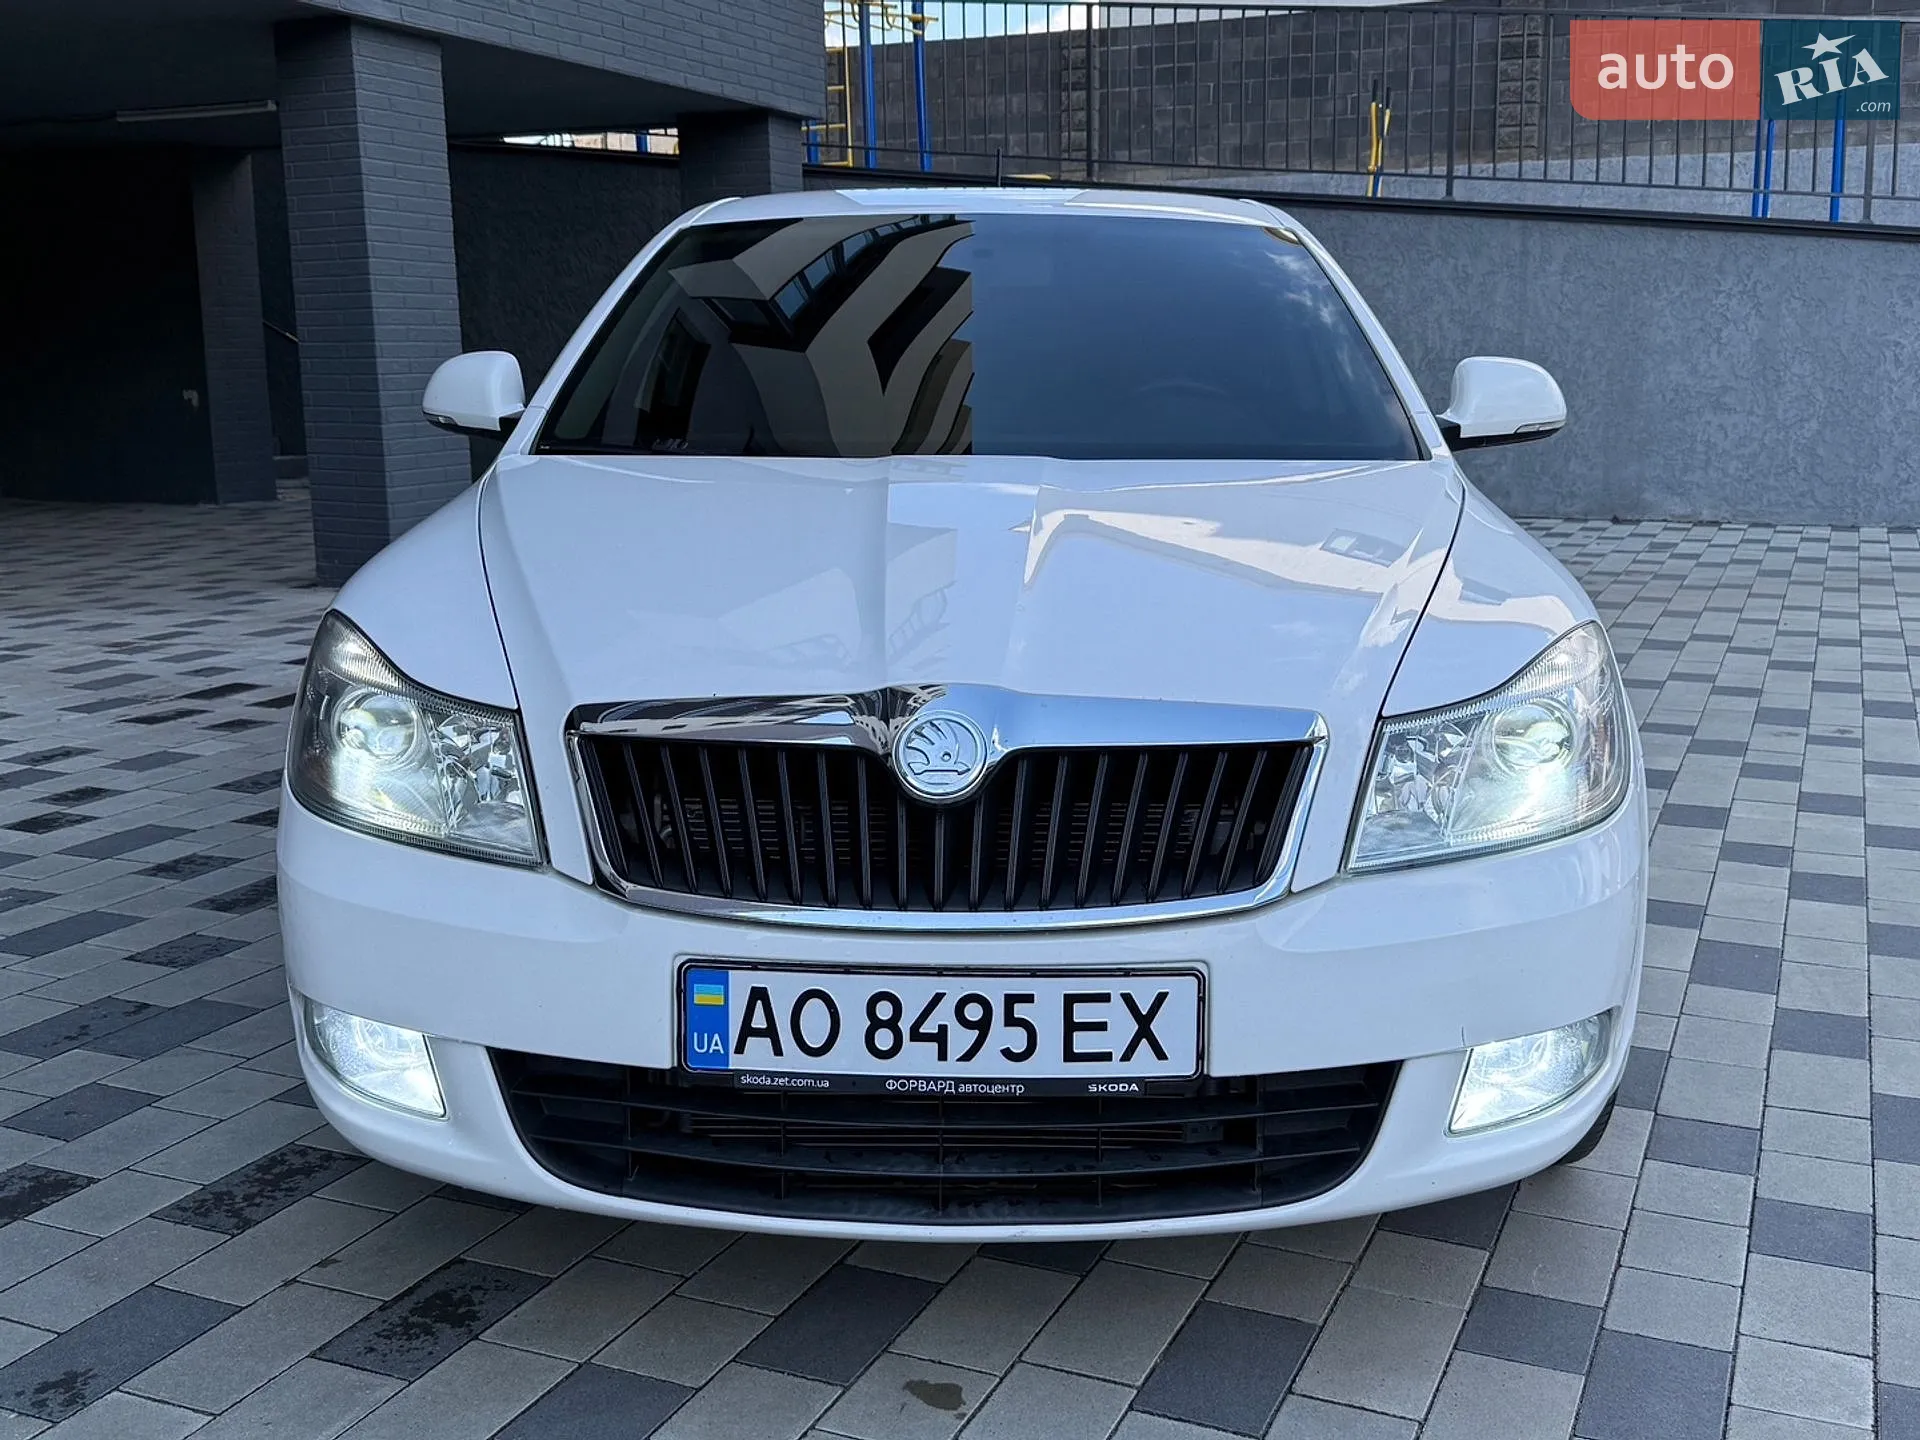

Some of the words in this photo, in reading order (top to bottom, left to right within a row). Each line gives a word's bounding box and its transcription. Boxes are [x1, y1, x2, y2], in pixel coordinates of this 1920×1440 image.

[734, 986, 840, 1058] AO
[865, 990, 1038, 1062] 8495
[1063, 991, 1170, 1063] EX
[693, 1032, 724, 1054] UA
[740, 1074, 830, 1088] skoda.zet.com.ua
[885, 1079, 955, 1094] ФОРВАРД
[958, 1081, 1025, 1095] автоцентр
[1088, 1083, 1139, 1092] SKODA
